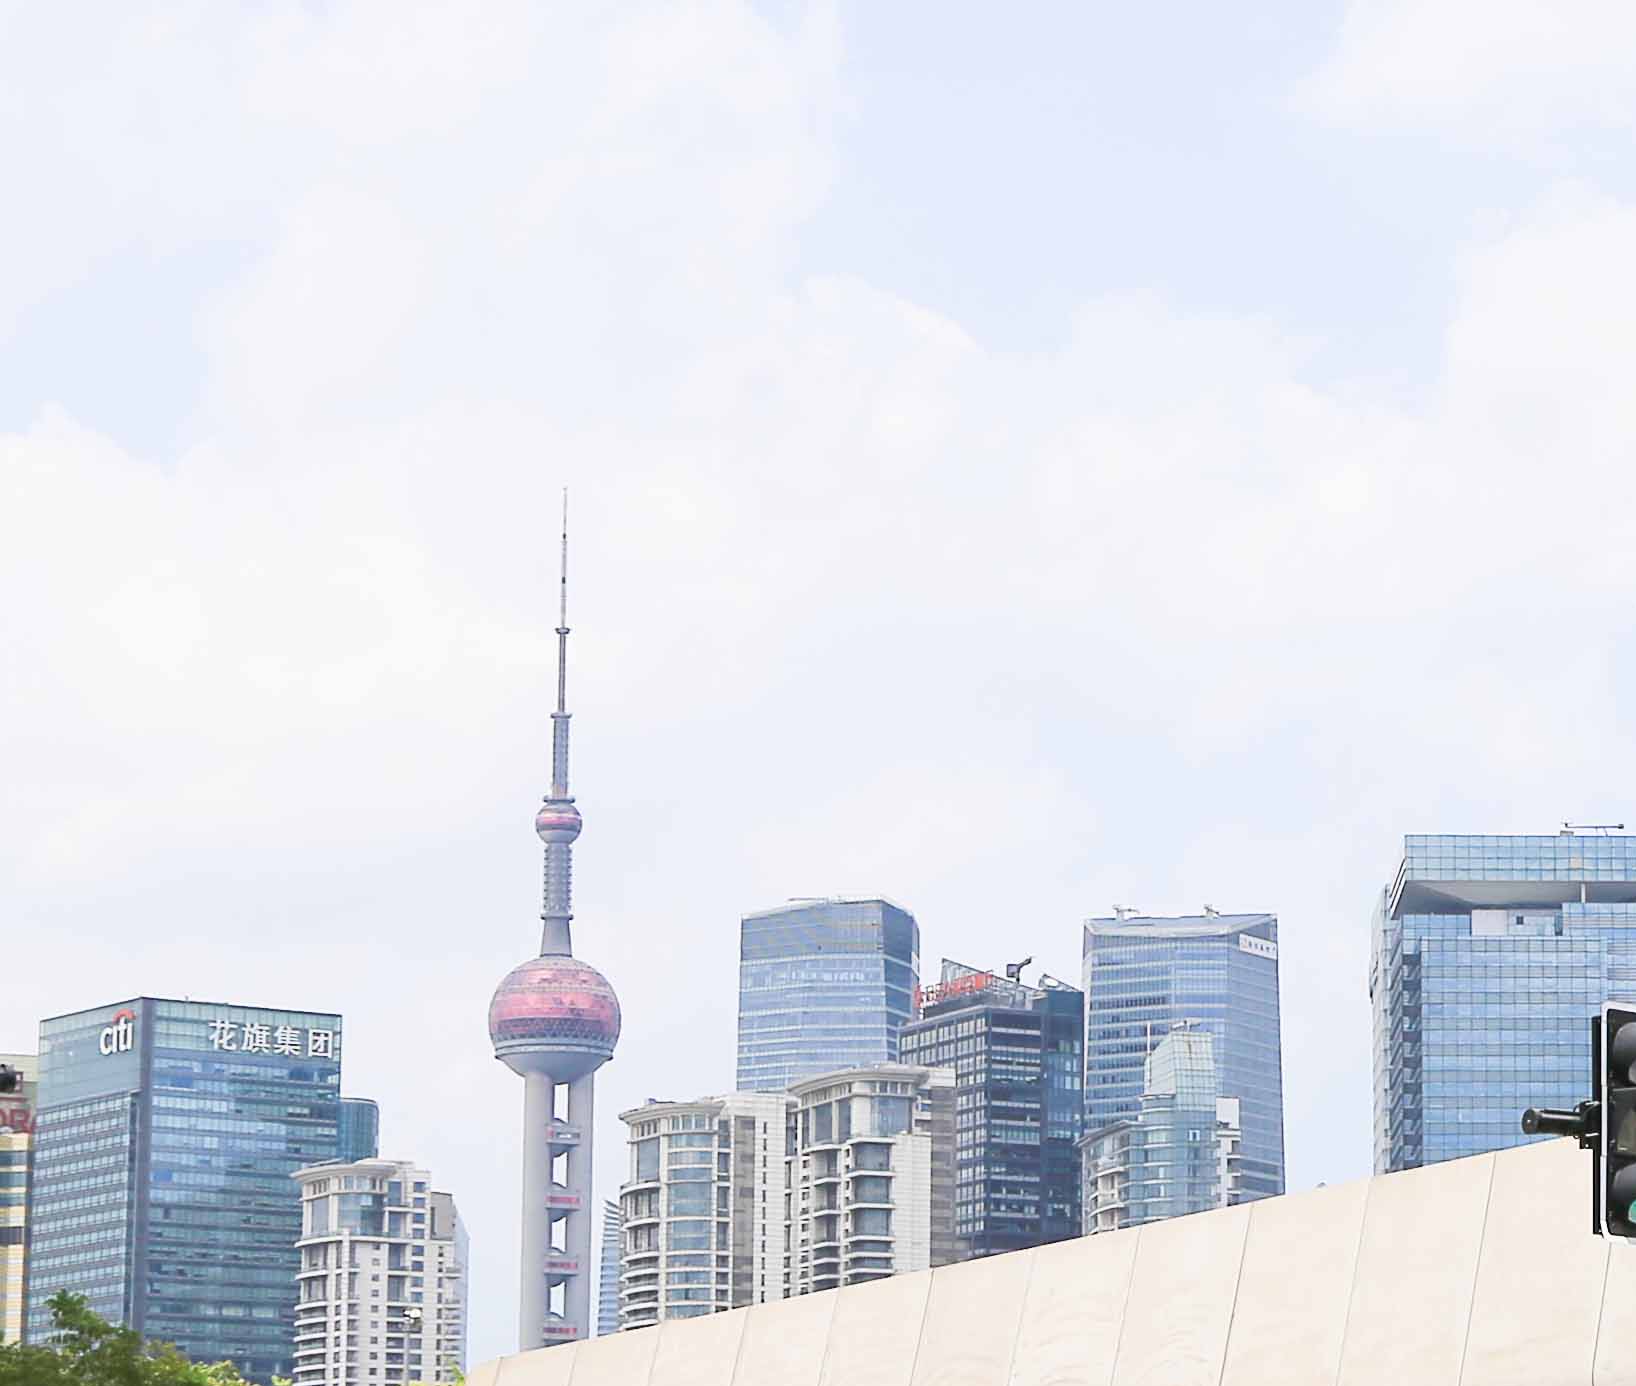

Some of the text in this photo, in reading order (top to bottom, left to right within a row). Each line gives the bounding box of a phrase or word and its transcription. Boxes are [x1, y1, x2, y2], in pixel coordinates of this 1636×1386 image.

[100, 1013, 135, 1056] citi
[208, 1019, 334, 1058] 花旗集团
